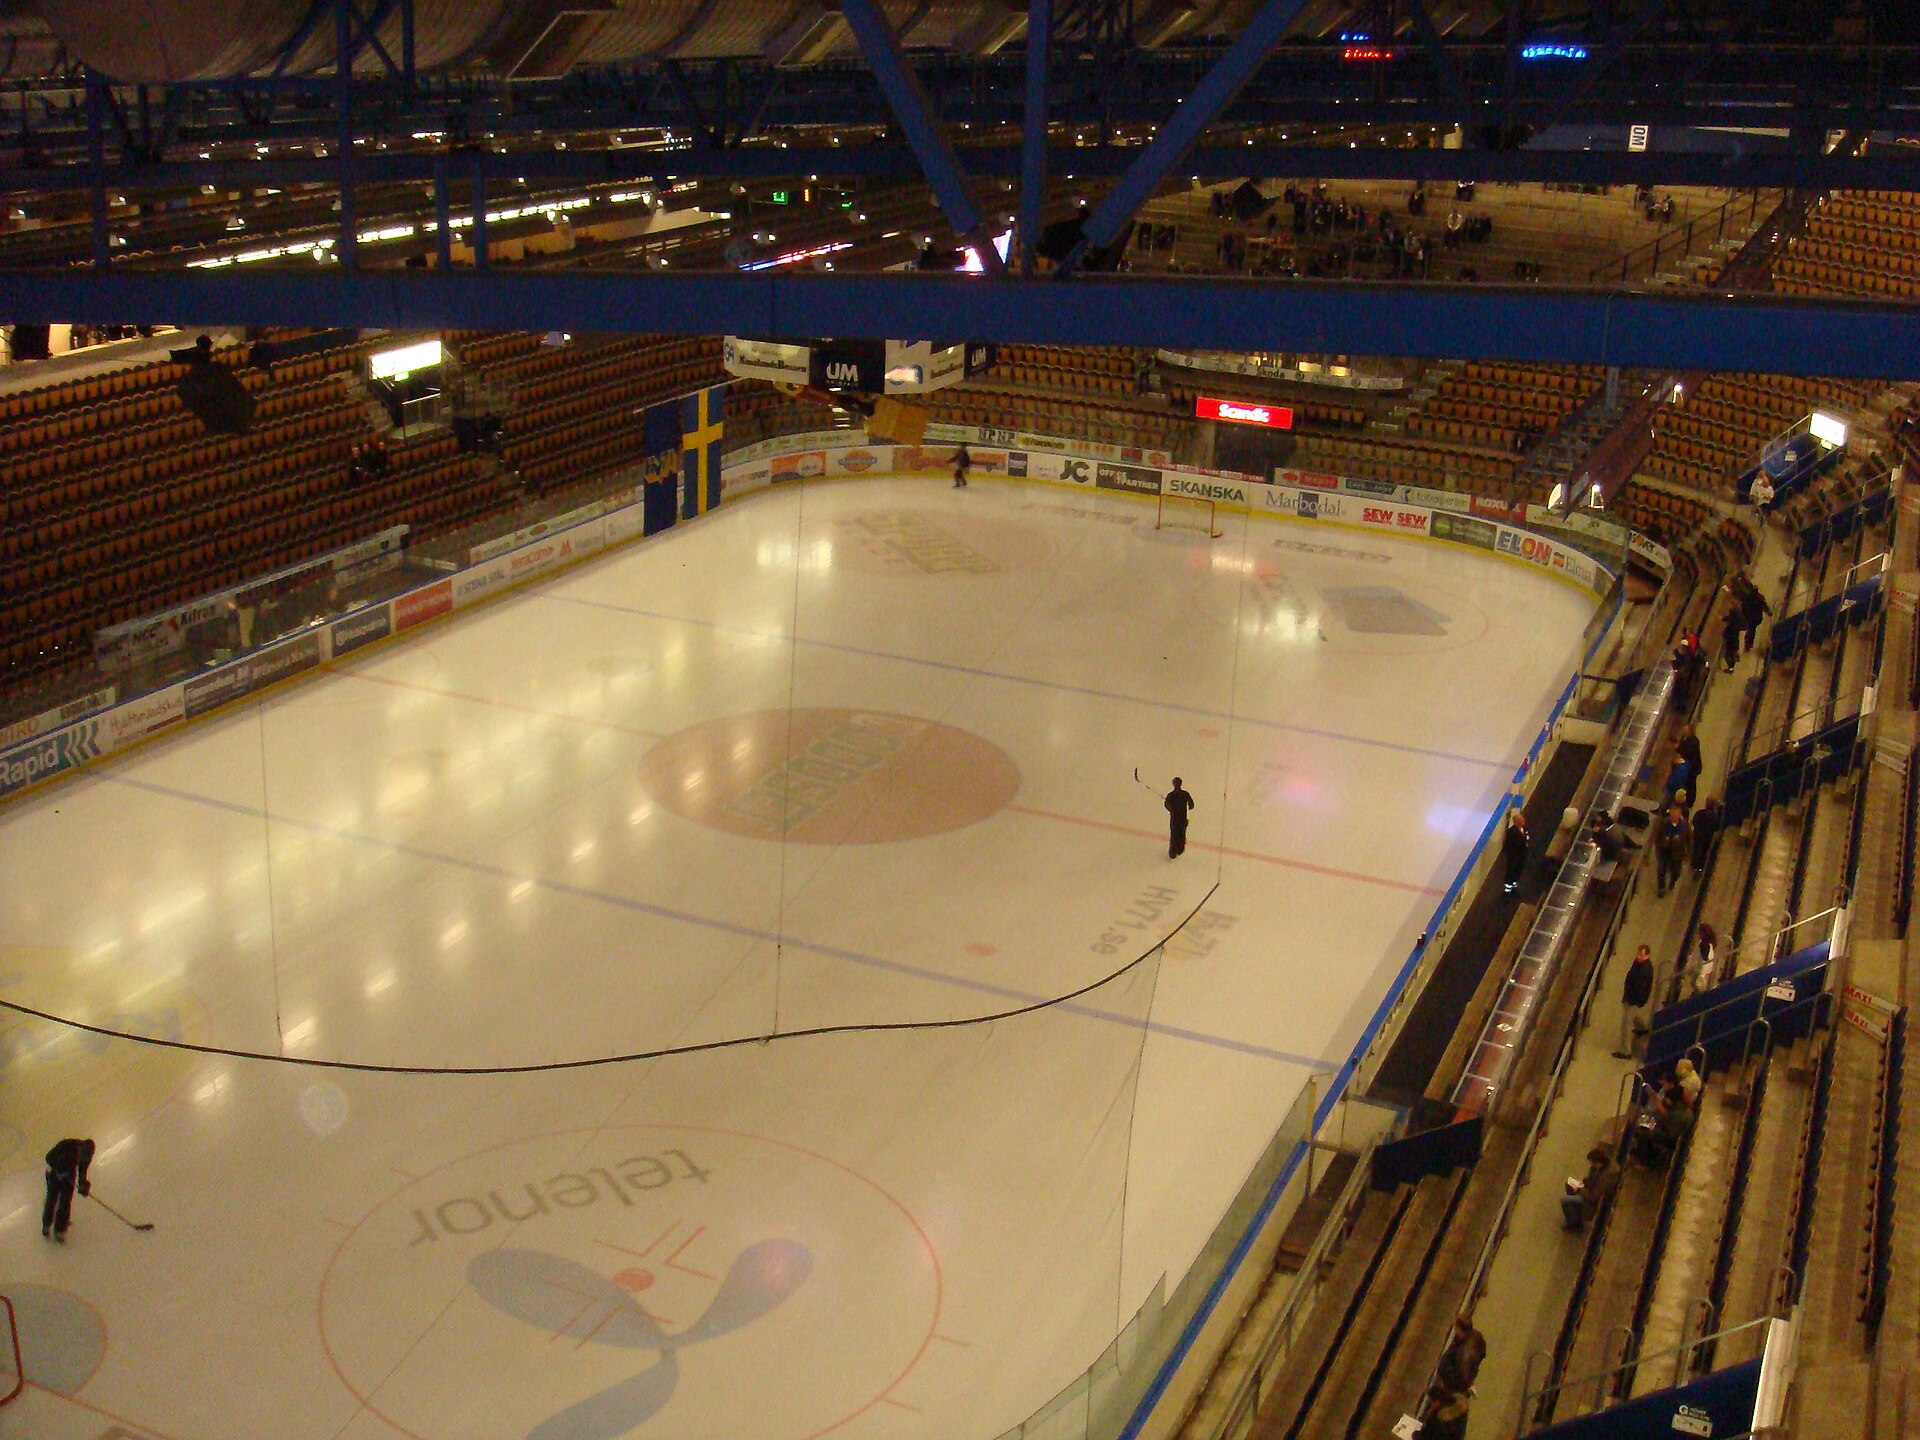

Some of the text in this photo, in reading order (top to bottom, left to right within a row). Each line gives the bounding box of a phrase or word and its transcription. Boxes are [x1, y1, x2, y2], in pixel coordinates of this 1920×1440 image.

[826, 362, 859, 380] UM
[1060, 460, 1090, 483] JC
[1169, 479, 1244, 502] SKANSKA
[1266, 490, 1342, 517] Marbodal
[1363, 507, 1427, 529] SEW SEW
[1498, 530, 1551, 565] ELON
[0, 739, 59, 785] Rapid
[409, 1149, 711, 1248] telenor
